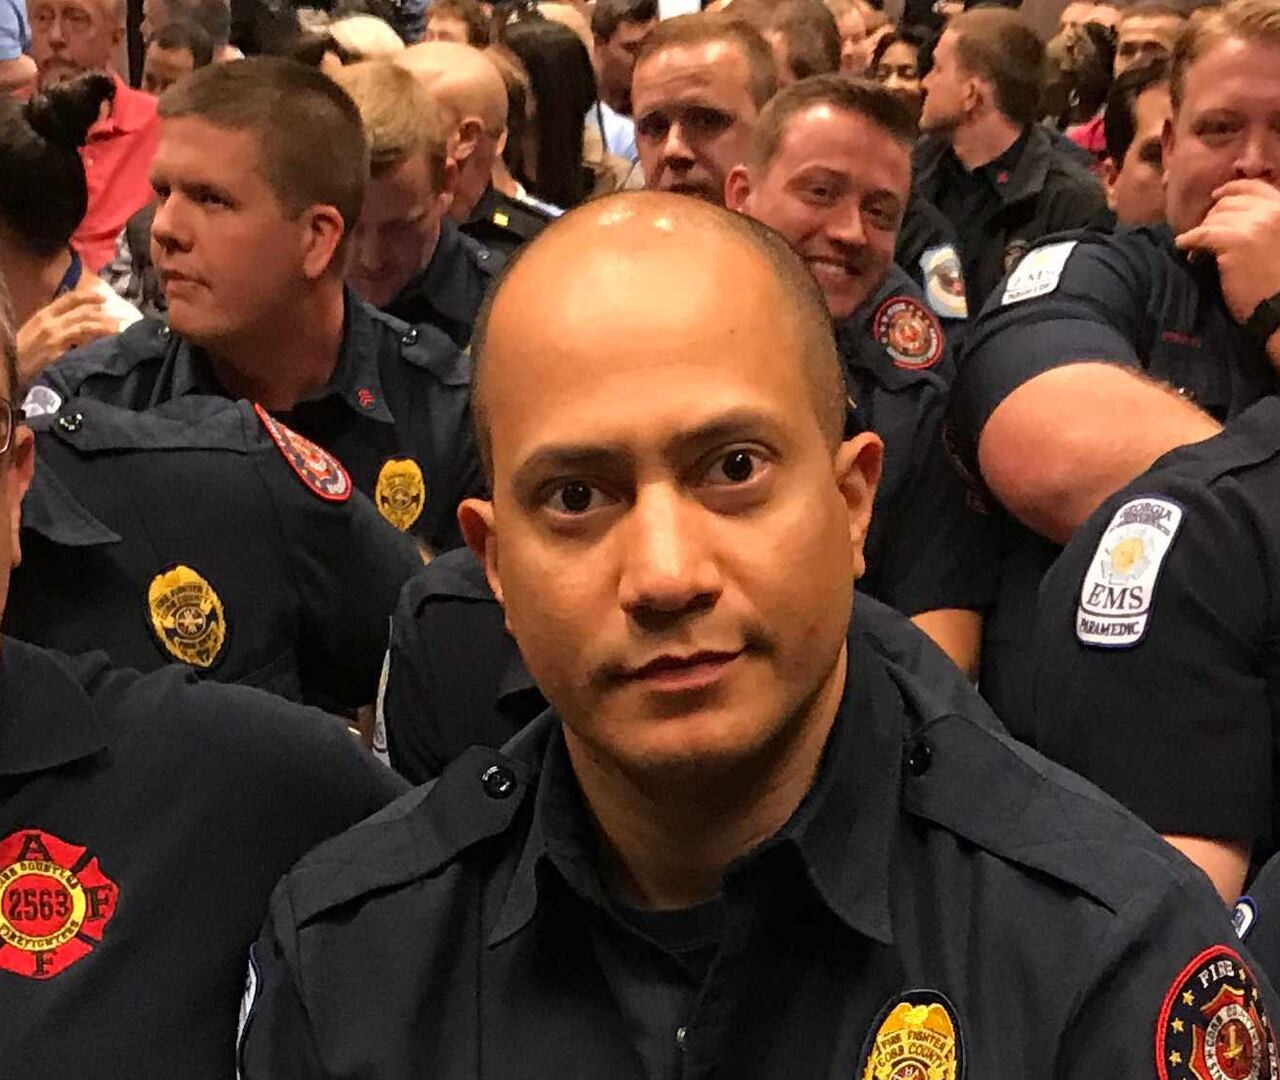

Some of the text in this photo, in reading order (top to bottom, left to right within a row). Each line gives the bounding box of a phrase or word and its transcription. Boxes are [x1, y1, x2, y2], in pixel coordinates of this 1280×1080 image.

[1086, 582, 1144, 610] EMS
[1079, 618, 1141, 637] PARAMEDIC
[8, 888, 70, 921] 2563
[1198, 960, 1235, 988] FIRE
[881, 1030, 946, 1053] FIRE FIGHTER
[878, 1043, 946, 1070] COBB COUNTY
